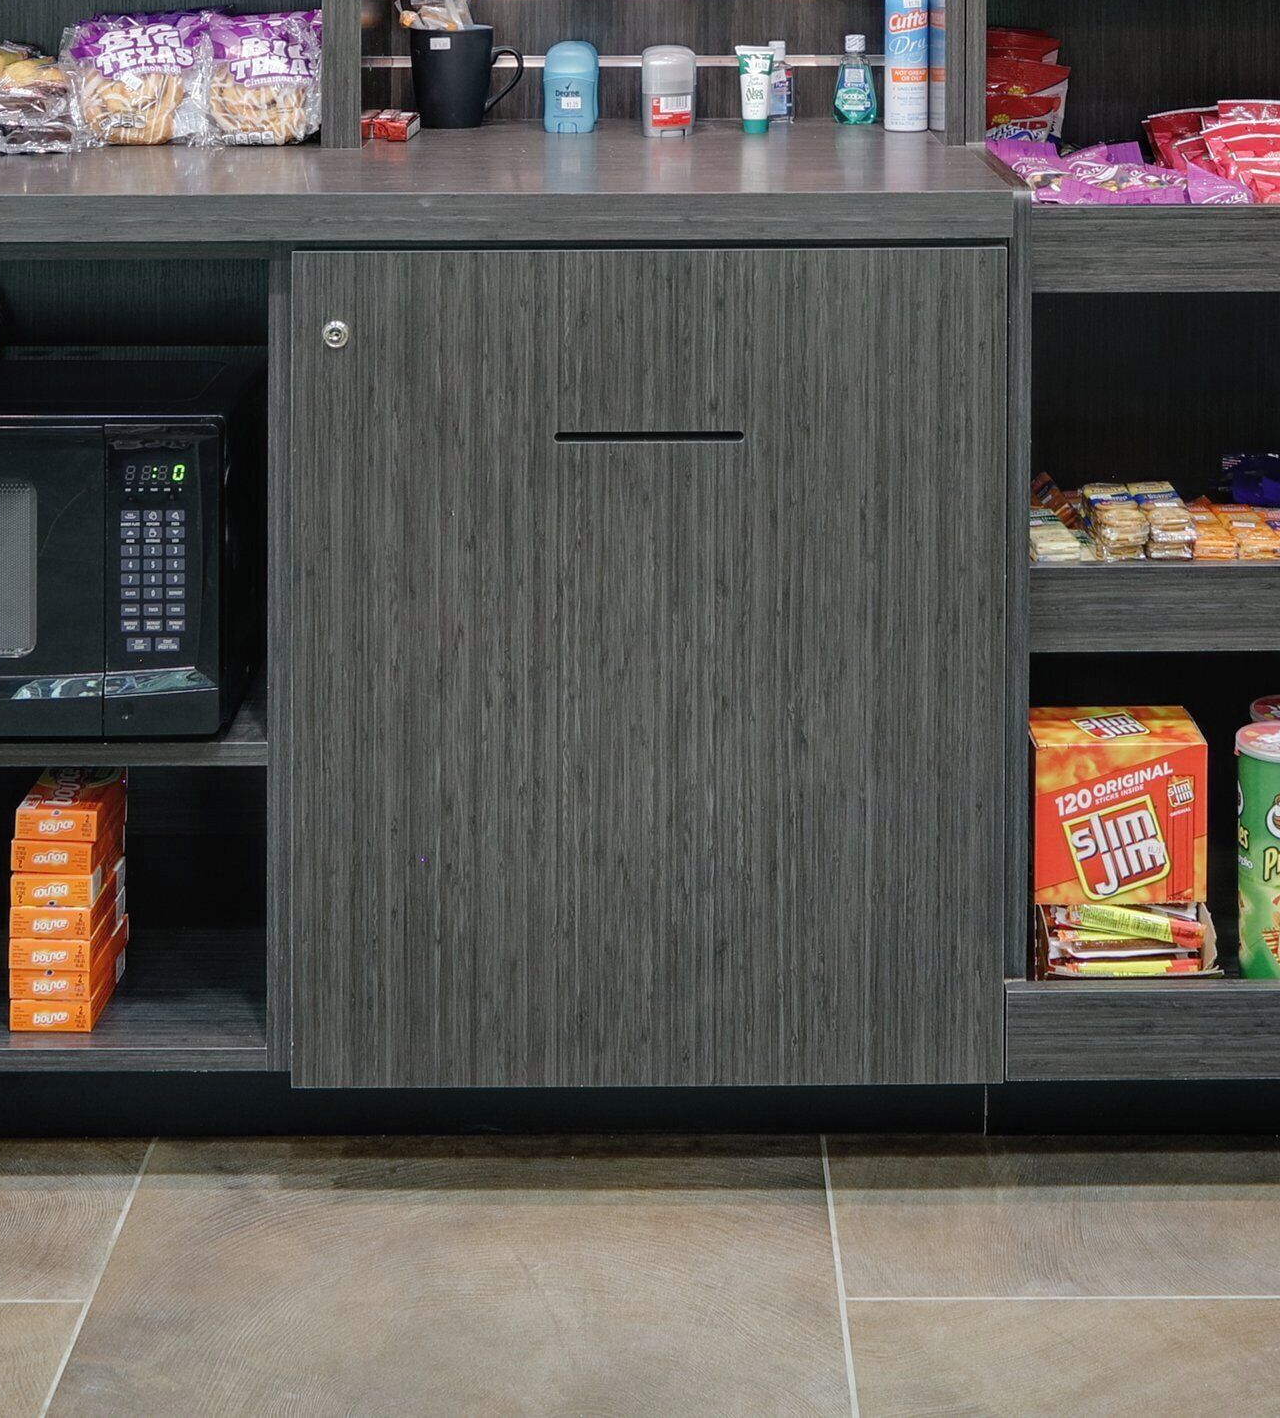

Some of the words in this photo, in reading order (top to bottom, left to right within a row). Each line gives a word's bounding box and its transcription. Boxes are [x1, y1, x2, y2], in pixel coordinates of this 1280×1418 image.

[889, 12, 928, 31] Cutter
[99, 24, 183, 50] BIG
[96, 47, 194, 75] TEXAS
[555, 89, 579, 99] Degree
[173, 465, 185, 481] 0
[1055, 789, 1092, 817] 120
[1093, 761, 1173, 797] ORIGINAL
[1072, 808, 1158, 861] slim
